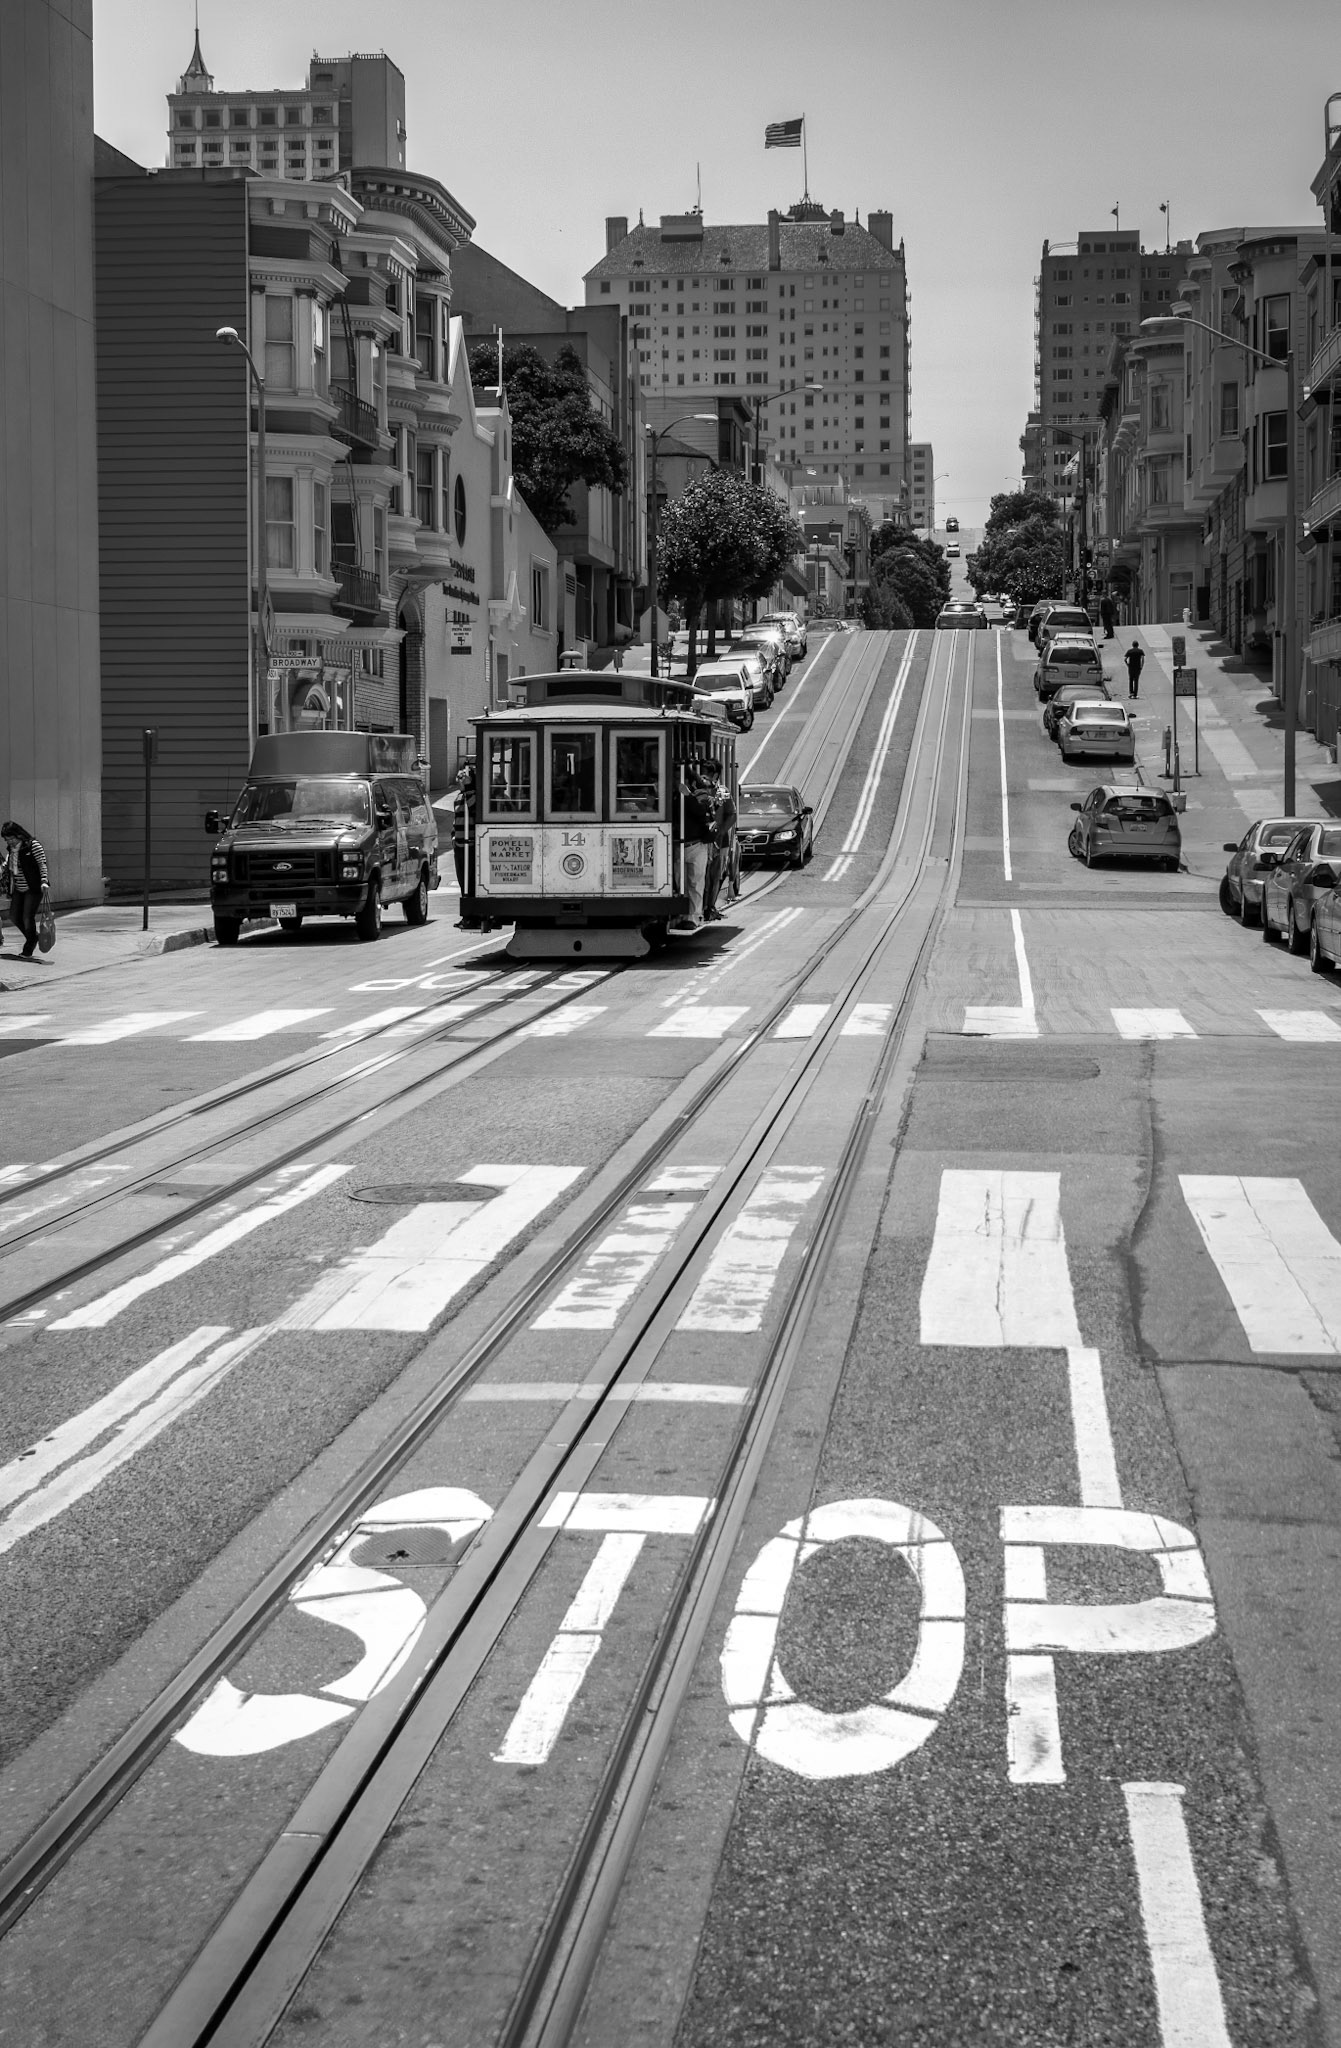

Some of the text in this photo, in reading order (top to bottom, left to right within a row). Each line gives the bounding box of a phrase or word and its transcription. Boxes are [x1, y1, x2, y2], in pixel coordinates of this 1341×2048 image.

[272, 658, 318, 667] BROADWAY
[561, 831, 586, 847] 14
[172, 1486, 1217, 1785] STOP
